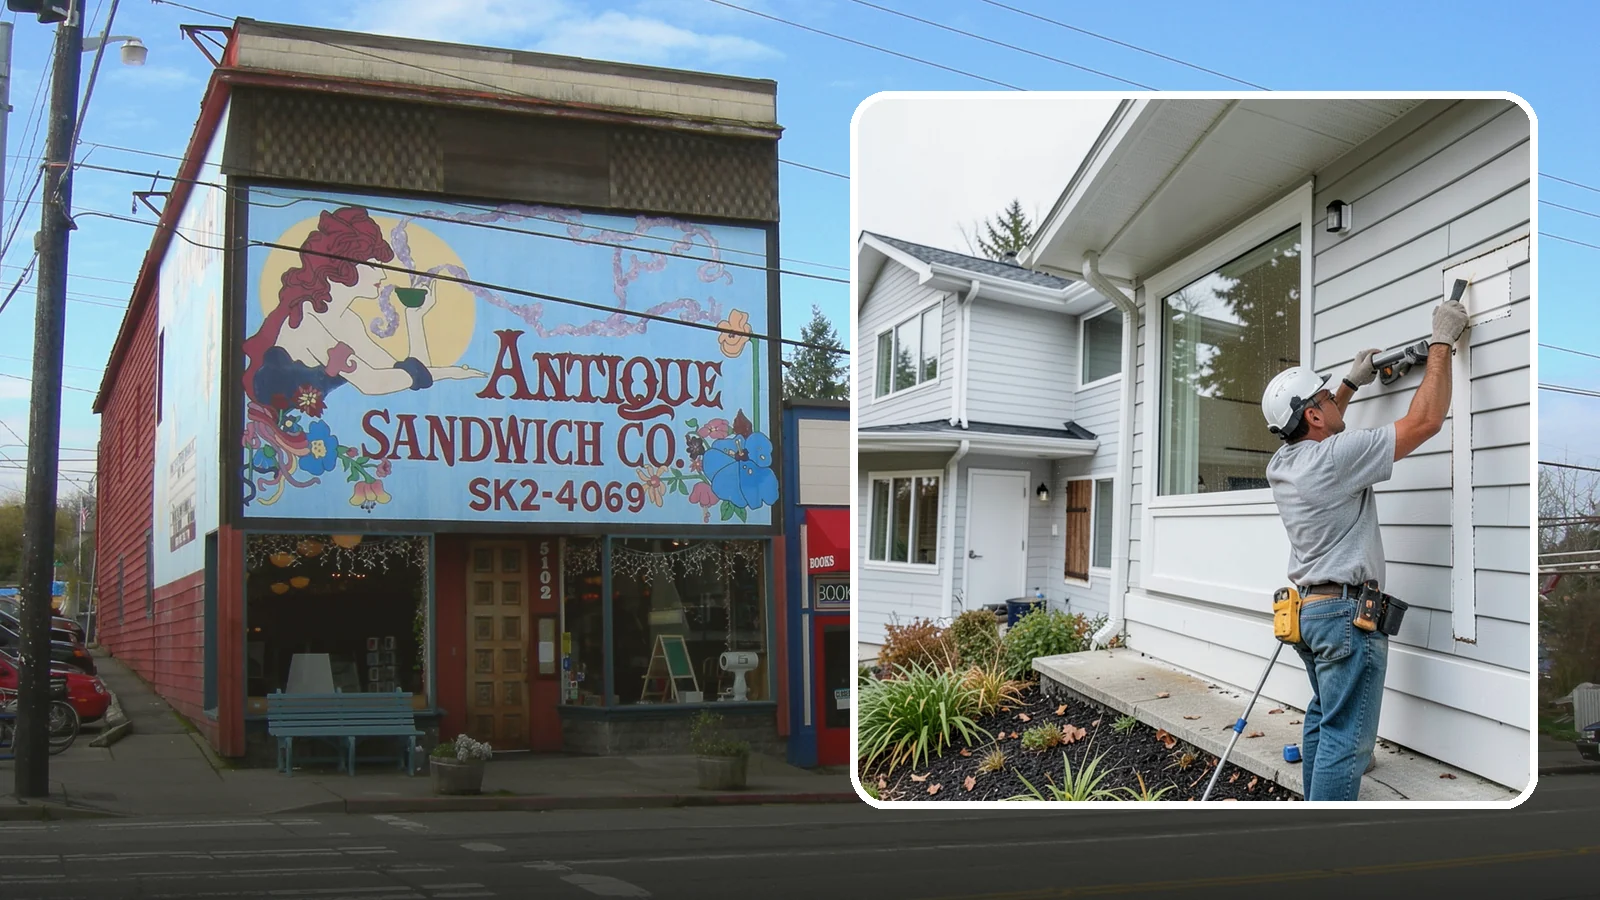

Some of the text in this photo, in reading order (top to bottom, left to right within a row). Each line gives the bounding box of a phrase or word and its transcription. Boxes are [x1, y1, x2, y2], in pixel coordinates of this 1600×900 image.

[361, 408, 685, 469] SANDWICH CO.
[468, 477, 646, 513] SK2-4069
[539, 541, 552, 600] 5102
[809, 555, 835, 569] BOOKS
